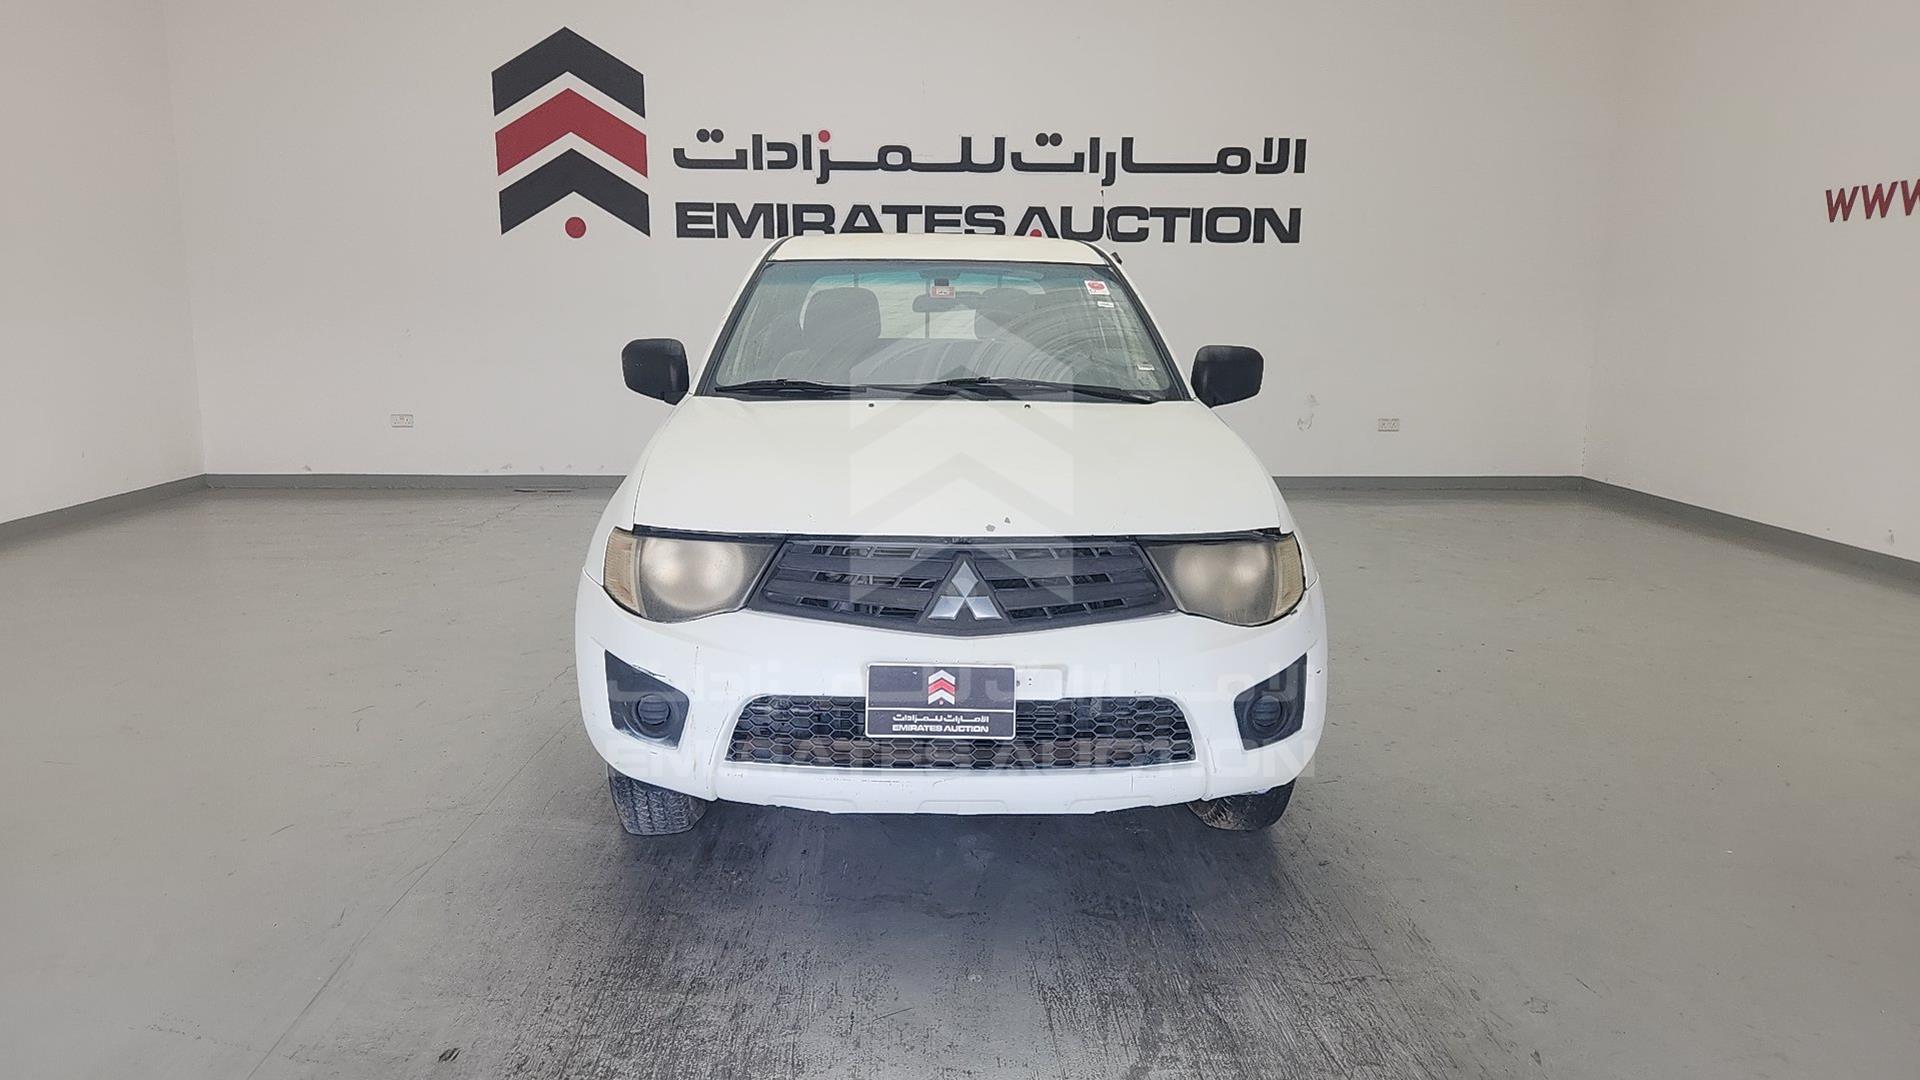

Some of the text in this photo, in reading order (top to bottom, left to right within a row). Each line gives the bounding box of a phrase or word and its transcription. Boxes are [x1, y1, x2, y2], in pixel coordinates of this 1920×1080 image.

[673, 128, 1307, 187] الامارات للمزادات
[675, 202, 1302, 244] EMIRATES AUCTION
[892, 724, 989, 733] EMIRATES AUCTION
